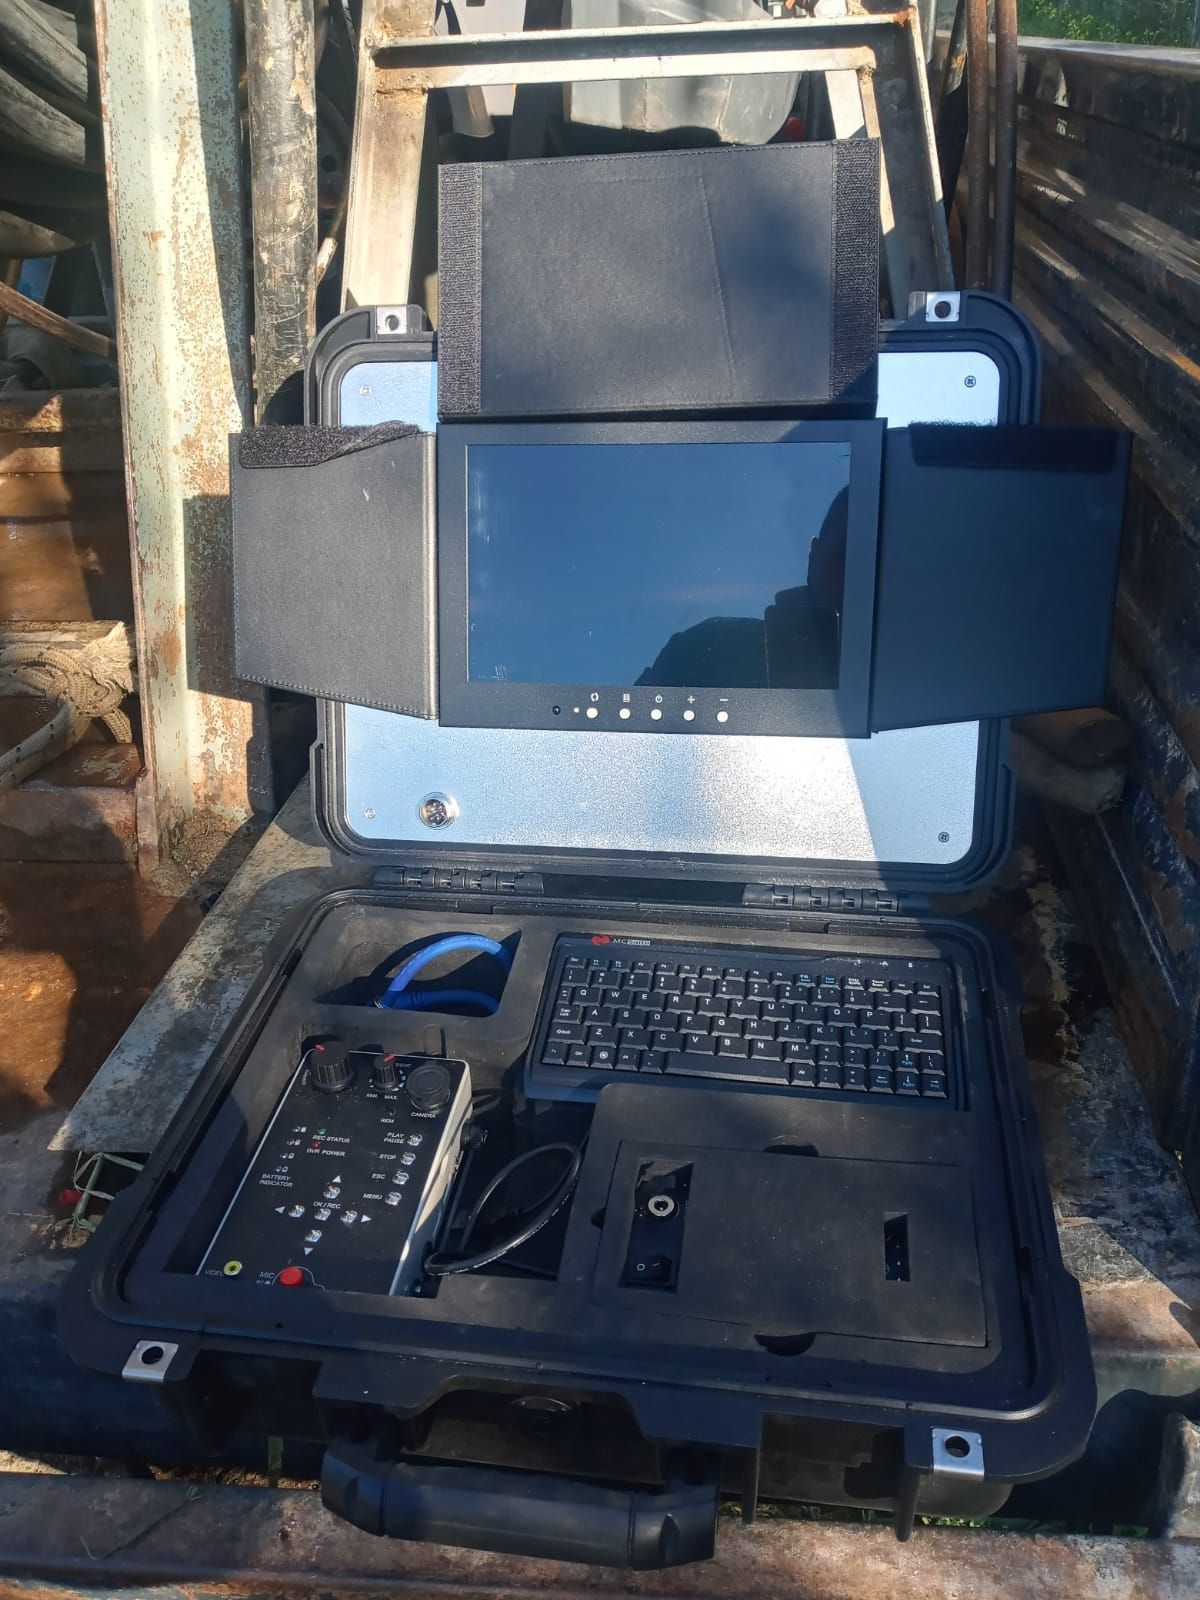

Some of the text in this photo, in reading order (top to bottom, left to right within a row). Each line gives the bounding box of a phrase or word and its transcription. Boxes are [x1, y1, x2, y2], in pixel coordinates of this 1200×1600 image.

[816, 1026, 824, 1034] K
[757, 1041, 765, 1049] N
[791, 1044, 799, 1052] M
